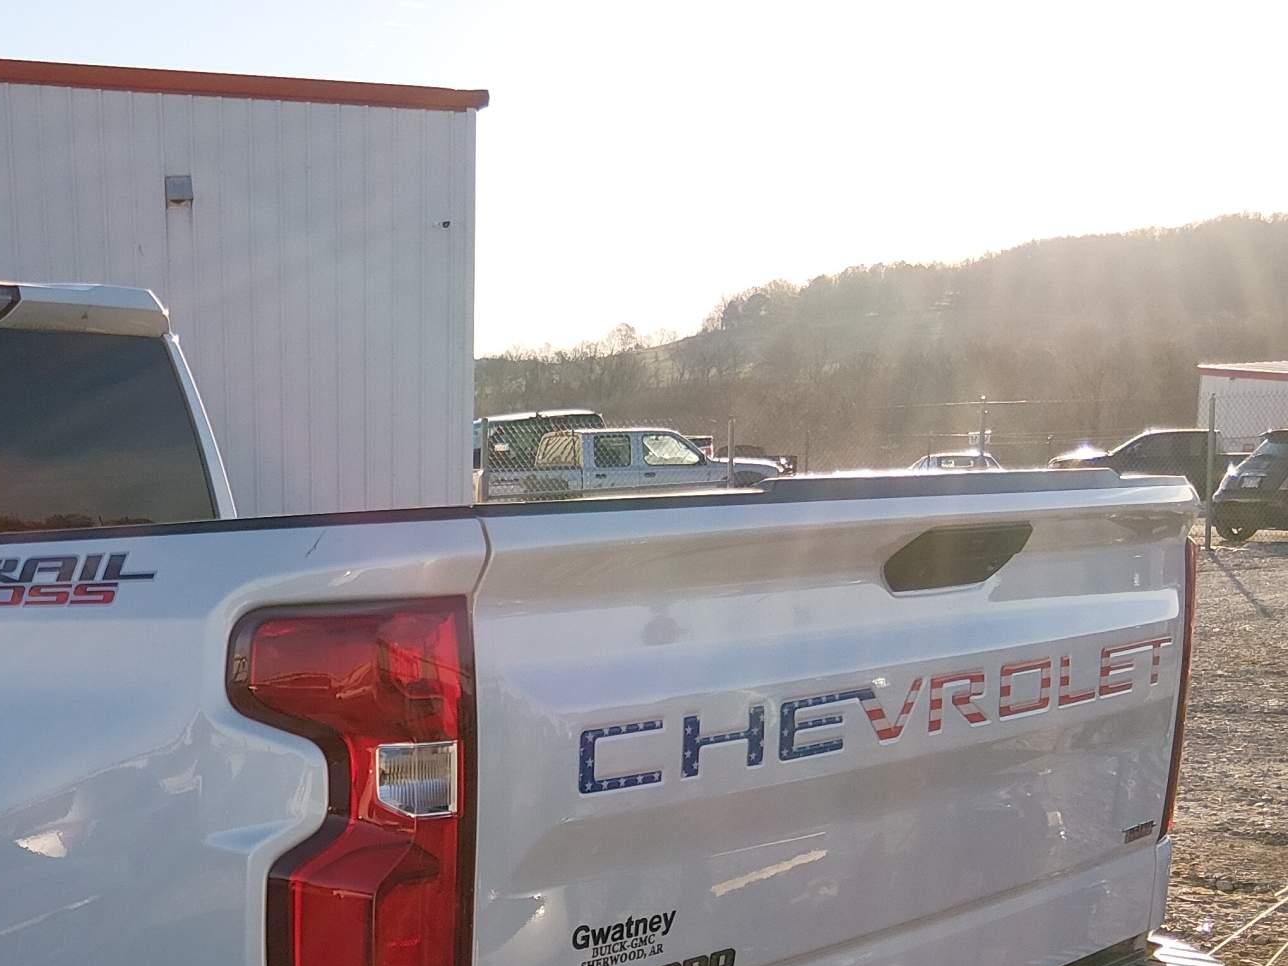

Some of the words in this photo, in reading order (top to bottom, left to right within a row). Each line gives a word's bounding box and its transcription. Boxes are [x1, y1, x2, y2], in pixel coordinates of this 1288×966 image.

[578, 637, 1173, 795] CHEVROLET
[572, 910, 677, 950] Gwatney
[591, 933, 656, 958] BUICK-GMC
[649, 943, 664, 957] AR
